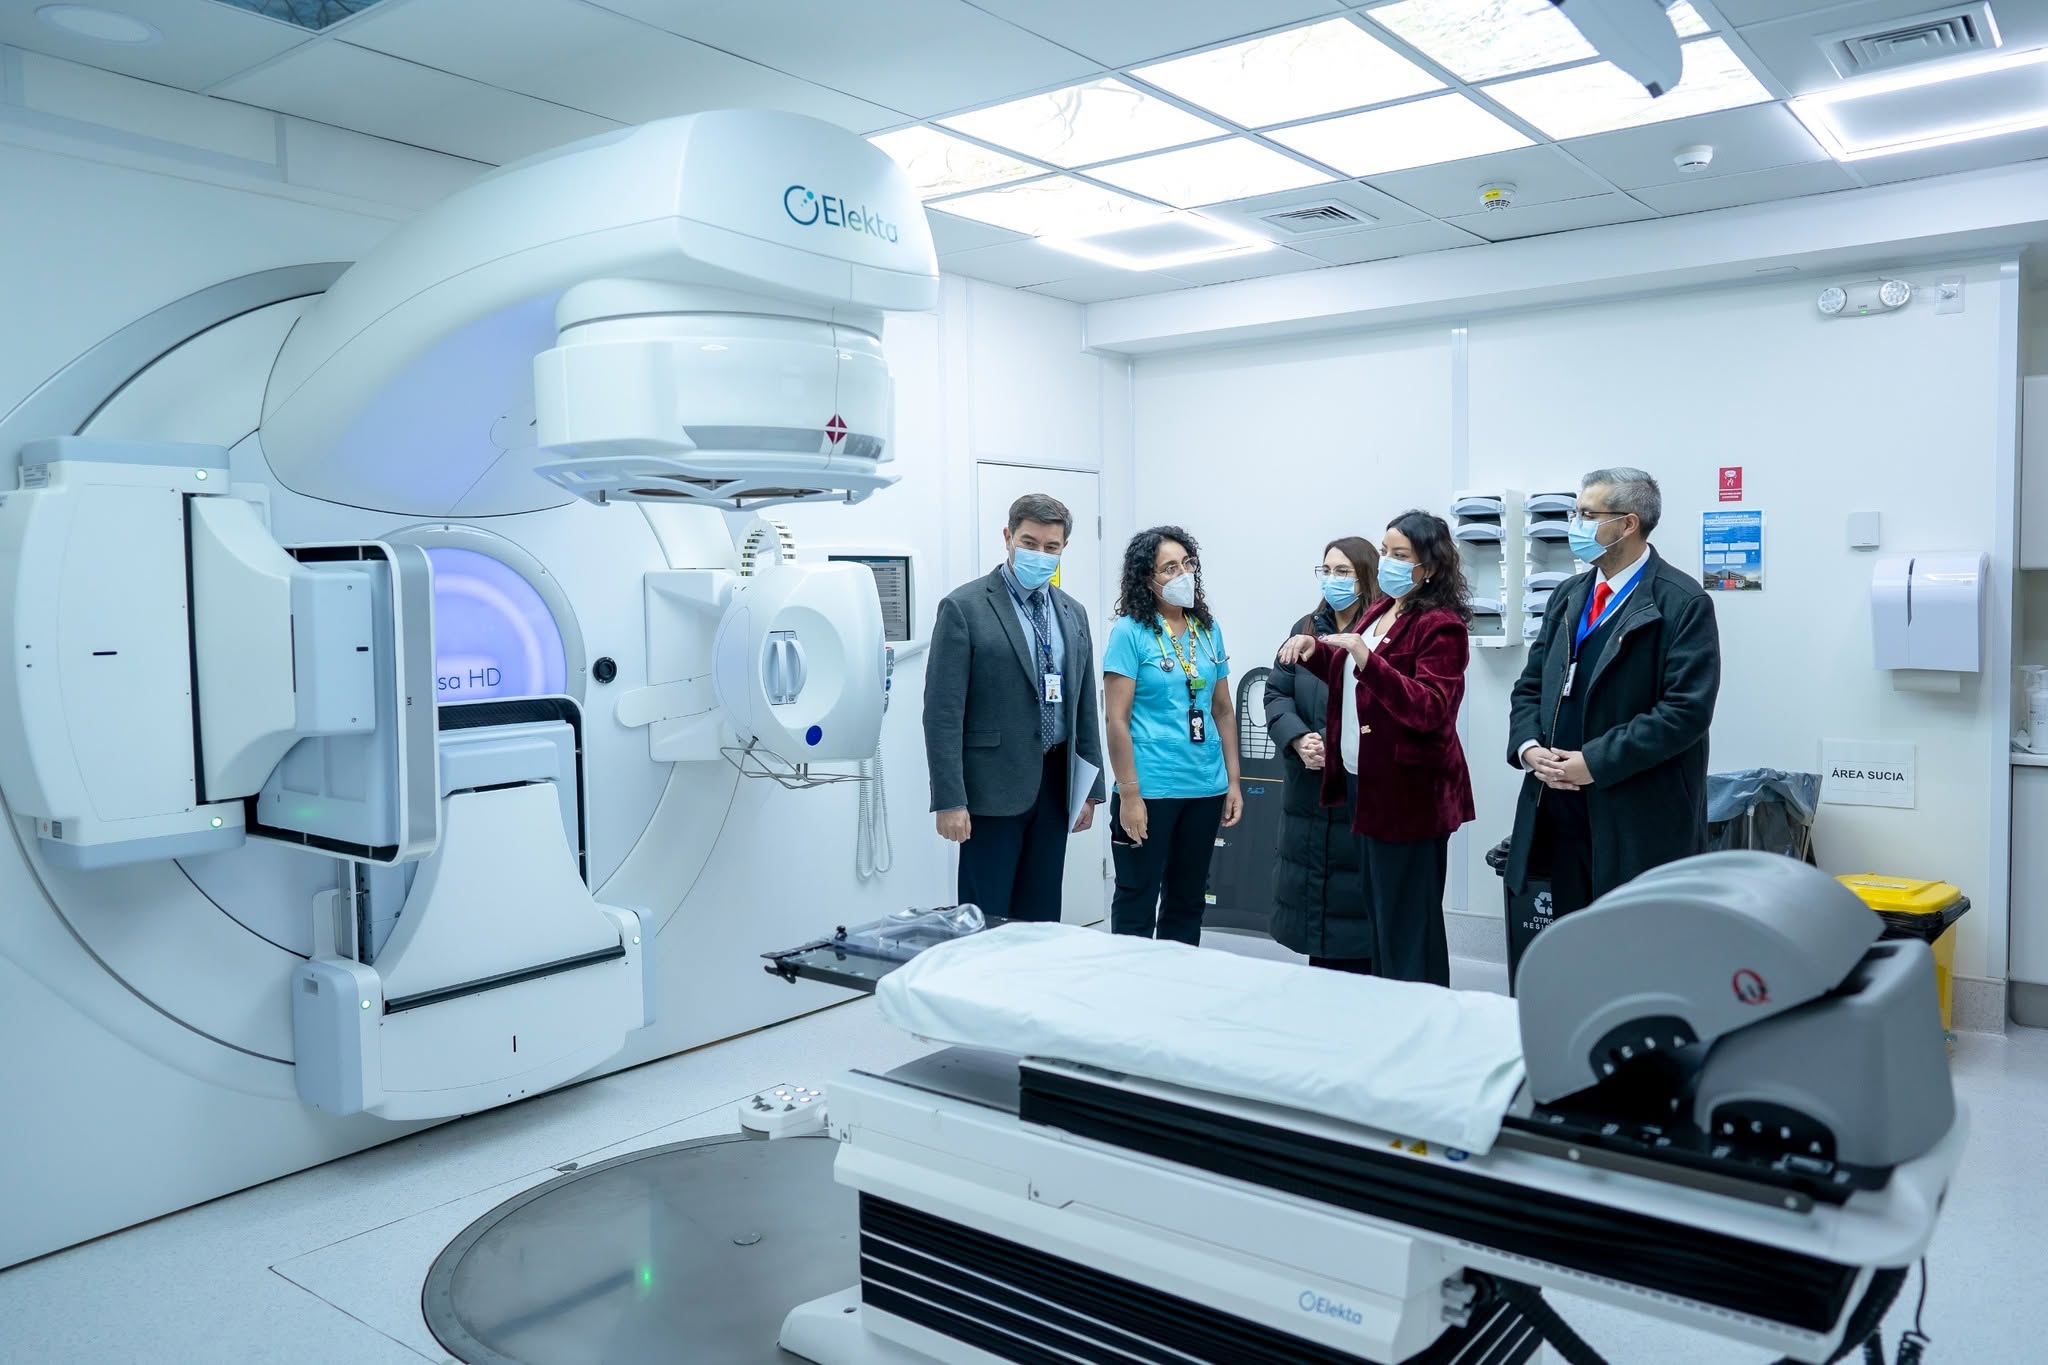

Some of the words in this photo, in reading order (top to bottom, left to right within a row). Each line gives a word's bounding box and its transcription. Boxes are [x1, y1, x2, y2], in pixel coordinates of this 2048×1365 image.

[821, 194, 898, 243] Elekta
[469, 667, 502, 688] HD
[1831, 767, 1865, 779] ÁREA
[1867, 770, 1905, 781] SUCIA
[1316, 1297, 1362, 1325] Elekta
